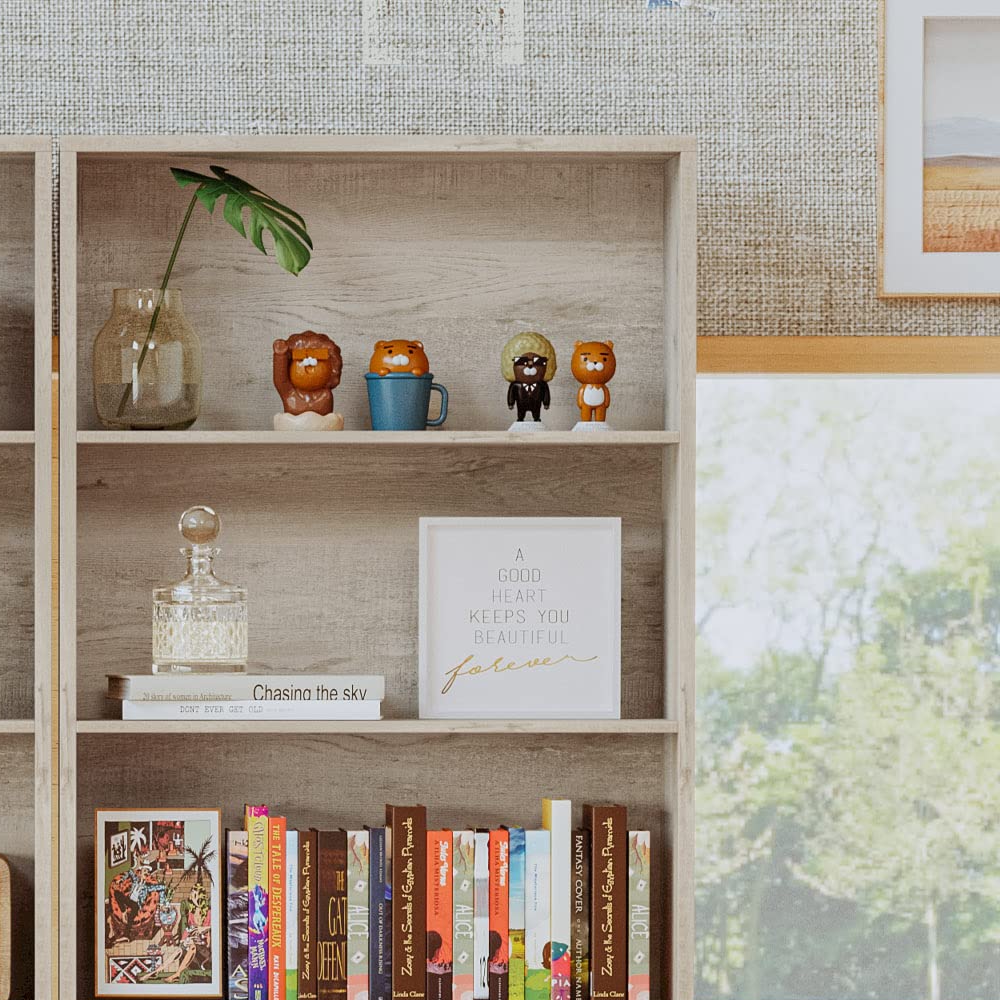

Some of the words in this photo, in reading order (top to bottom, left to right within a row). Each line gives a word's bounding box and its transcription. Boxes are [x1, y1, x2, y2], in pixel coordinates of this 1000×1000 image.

[515, 548, 524, 561] A
[498, 568, 541, 583] GOOD
[492, 589, 547, 603] HEART
[469, 609, 526, 624] KEEPS
[538, 609, 569, 624] YOU
[474, 629, 569, 644] BEAUTIFUL
[441, 654, 598, 694] forever
[253, 684, 312, 700] Chasing
[316, 684, 338, 700] the
[342, 684, 367, 700] sky
[272, 824, 280, 840] THE
[272, 844, 282, 870] TALE
[575, 835, 583, 876] FANTASY
[272, 873, 280, 884] OF
[575, 880, 583, 913] COVER
[271, 886, 282, 948] DESPEREAUX
[348, 904, 369, 940] ALICE
[378, 916, 384, 924] OF
[455, 904, 474, 940] ALICE
[630, 904, 649, 940] ALICE
[250, 946, 258, 968] MANN
[256, 938, 266, 971] MICHAEL
[575, 938, 583, 974] AUTHOR
[552, 979, 570, 987] PIA
